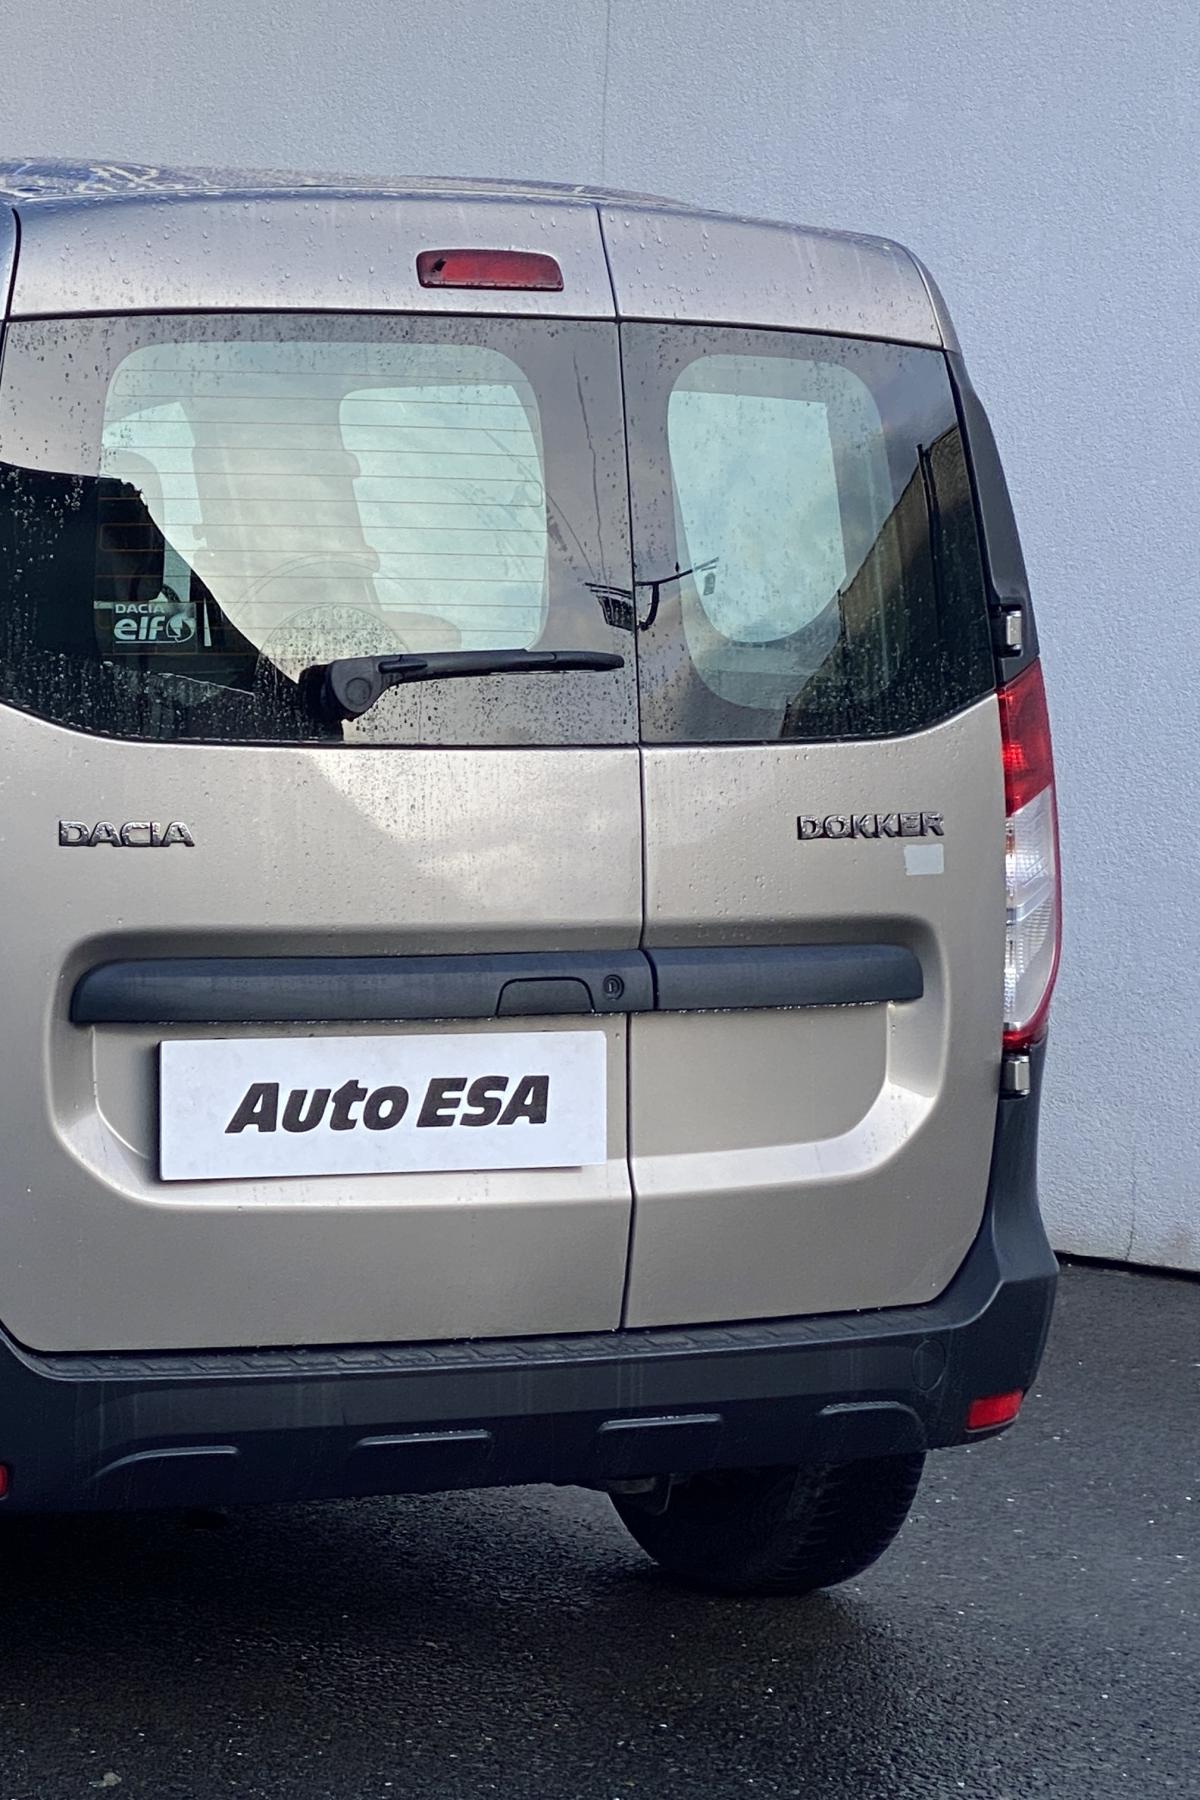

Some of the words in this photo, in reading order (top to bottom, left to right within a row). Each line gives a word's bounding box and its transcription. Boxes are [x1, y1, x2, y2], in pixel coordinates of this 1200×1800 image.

[115, 603, 165, 614] DACIA
[113, 616, 165, 640] elf
[58, 820, 195, 847] DACIA
[797, 812, 944, 840] DOKKER
[225, 1079, 409, 1134] Auto
[416, 1075, 550, 1128] ESA
